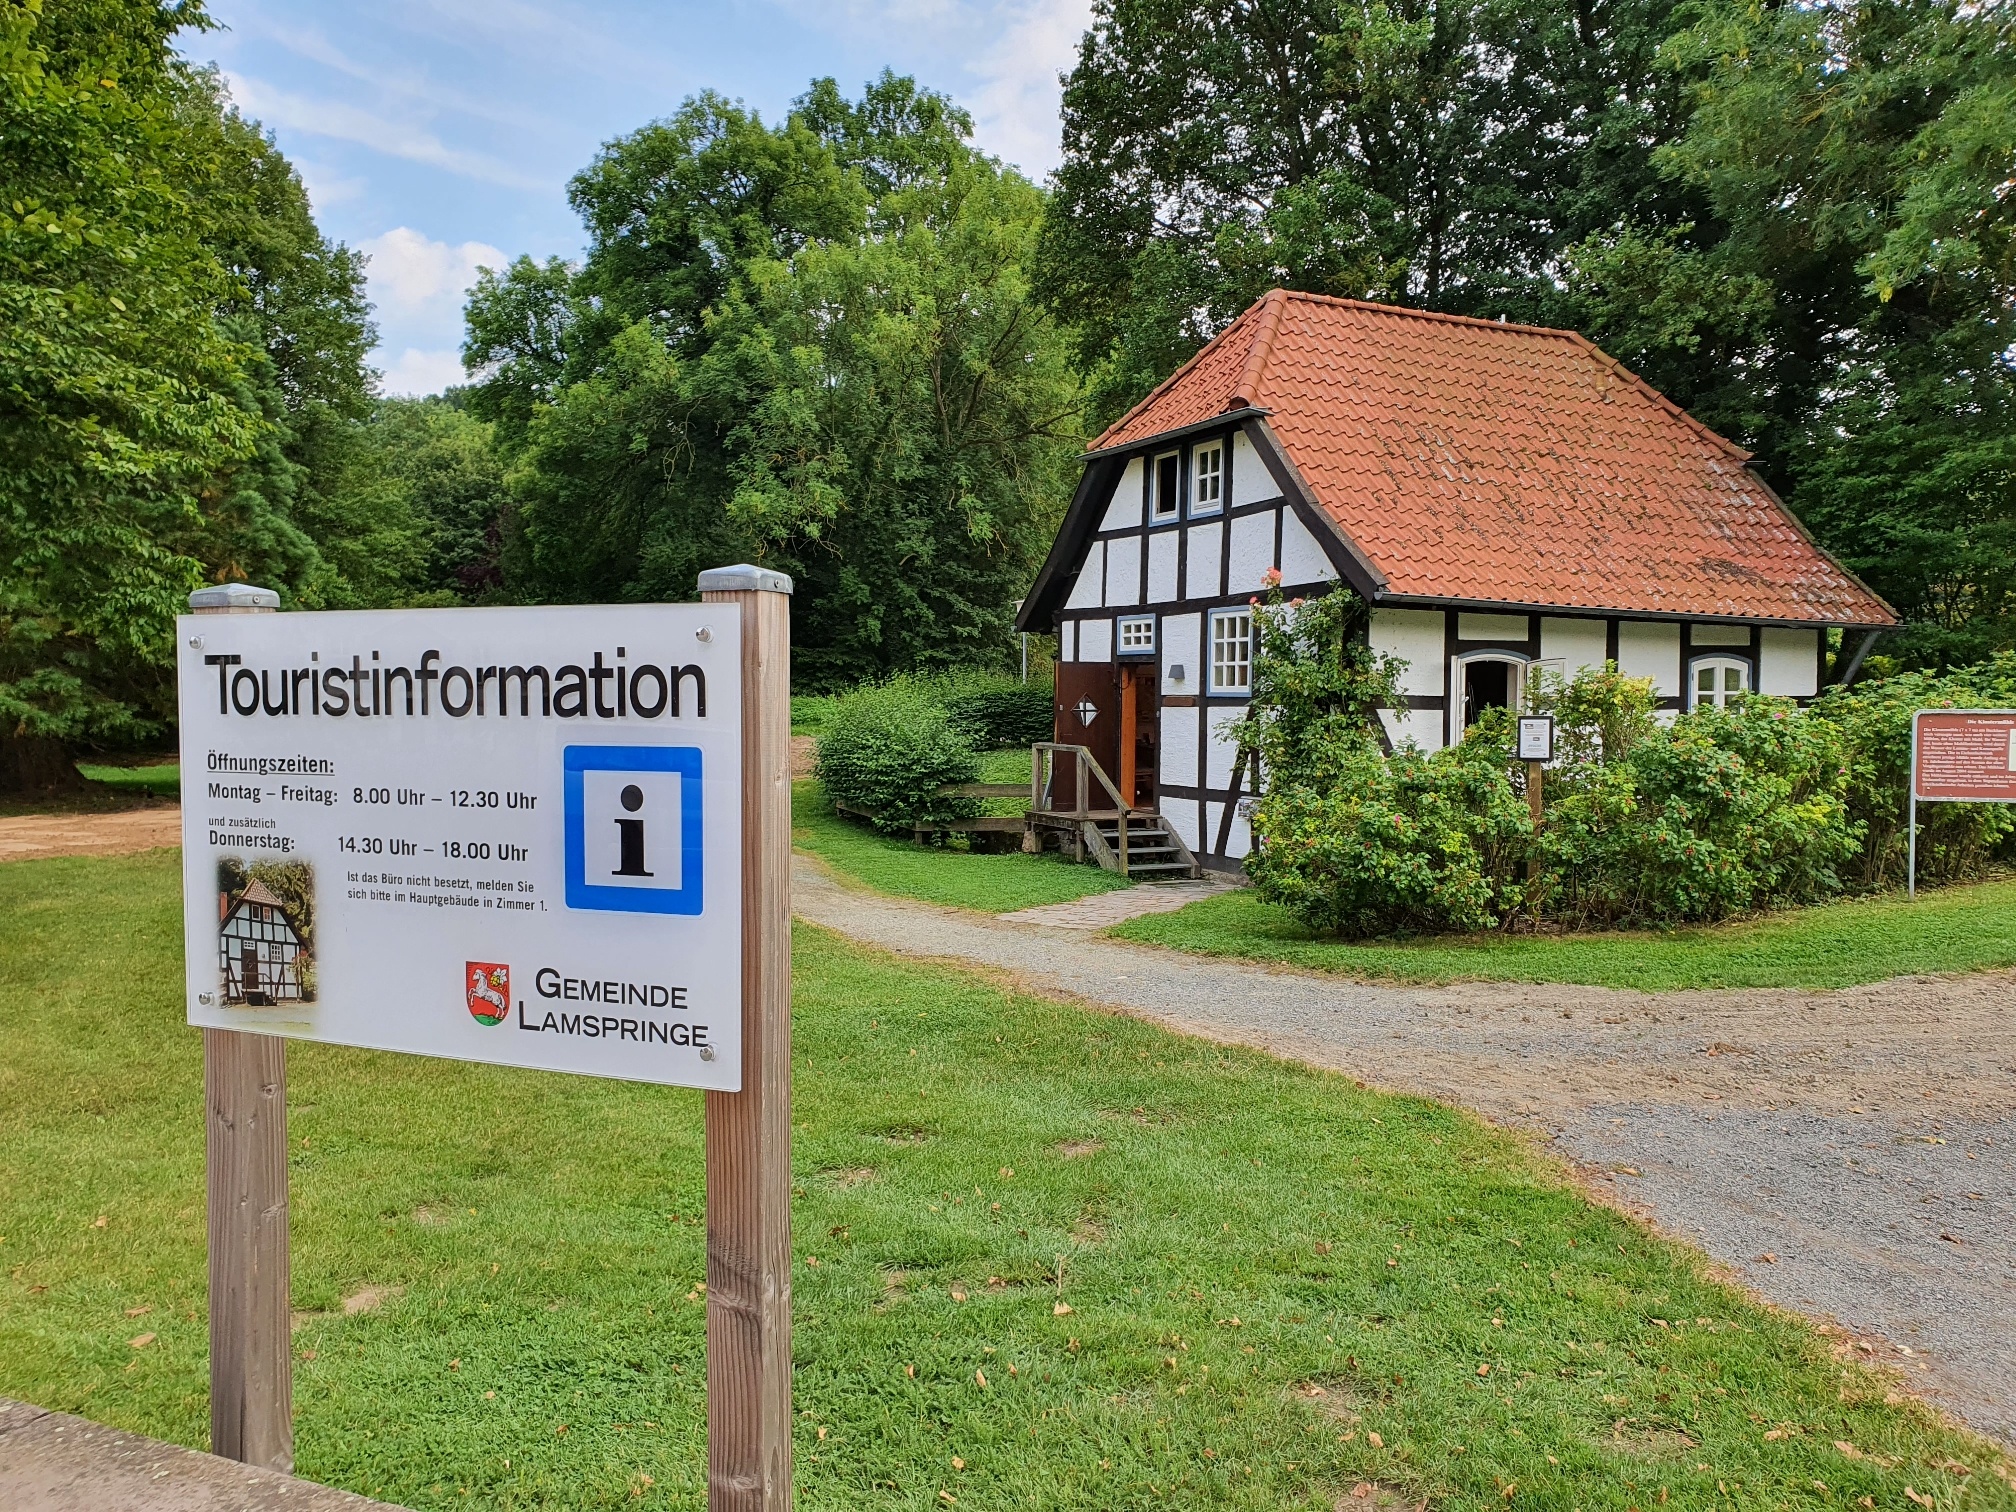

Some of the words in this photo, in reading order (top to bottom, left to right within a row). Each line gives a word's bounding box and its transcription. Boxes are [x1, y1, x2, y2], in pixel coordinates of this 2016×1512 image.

[204, 646, 708, 720] Touristinformation
[207, 749, 334, 776] Öffnungszeiten:
[208, 782, 262, 804] Montag
[281, 785, 338, 806] Freitag:
[353, 787, 391, 805] 8.00
[397, 788, 426, 806] Uhr
[449, 790, 499, 808] 12.30
[506, 791, 538, 810] Uhr
[208, 816, 225, 827] und
[228, 816, 276, 829] zusätzlich
[209, 830, 295, 853] Donnerstag:
[337, 836, 383, 854] 14.30
[389, 838, 418, 856] Uhr
[441, 841, 491, 860] 18.00
[498, 843, 529, 862] Uhr
[347, 871, 359, 883] Ist
[361, 872, 378, 884] das
[381, 873, 403, 885] Büro
[406, 875, 431, 887] nicht
[434, 876, 473, 891] besetzt,
[476, 879, 514, 892] melden
[517, 881, 535, 893] Sie
[347, 888, 367, 900] sich
[370, 890, 391, 901] bitte
[394, 891, 406, 903] im
[409, 892, 480, 908] Hauptgebäude
[483, 895, 493, 909] in
[496, 897, 535, 911] Zimmer
[539, 899, 548, 912] 1.
